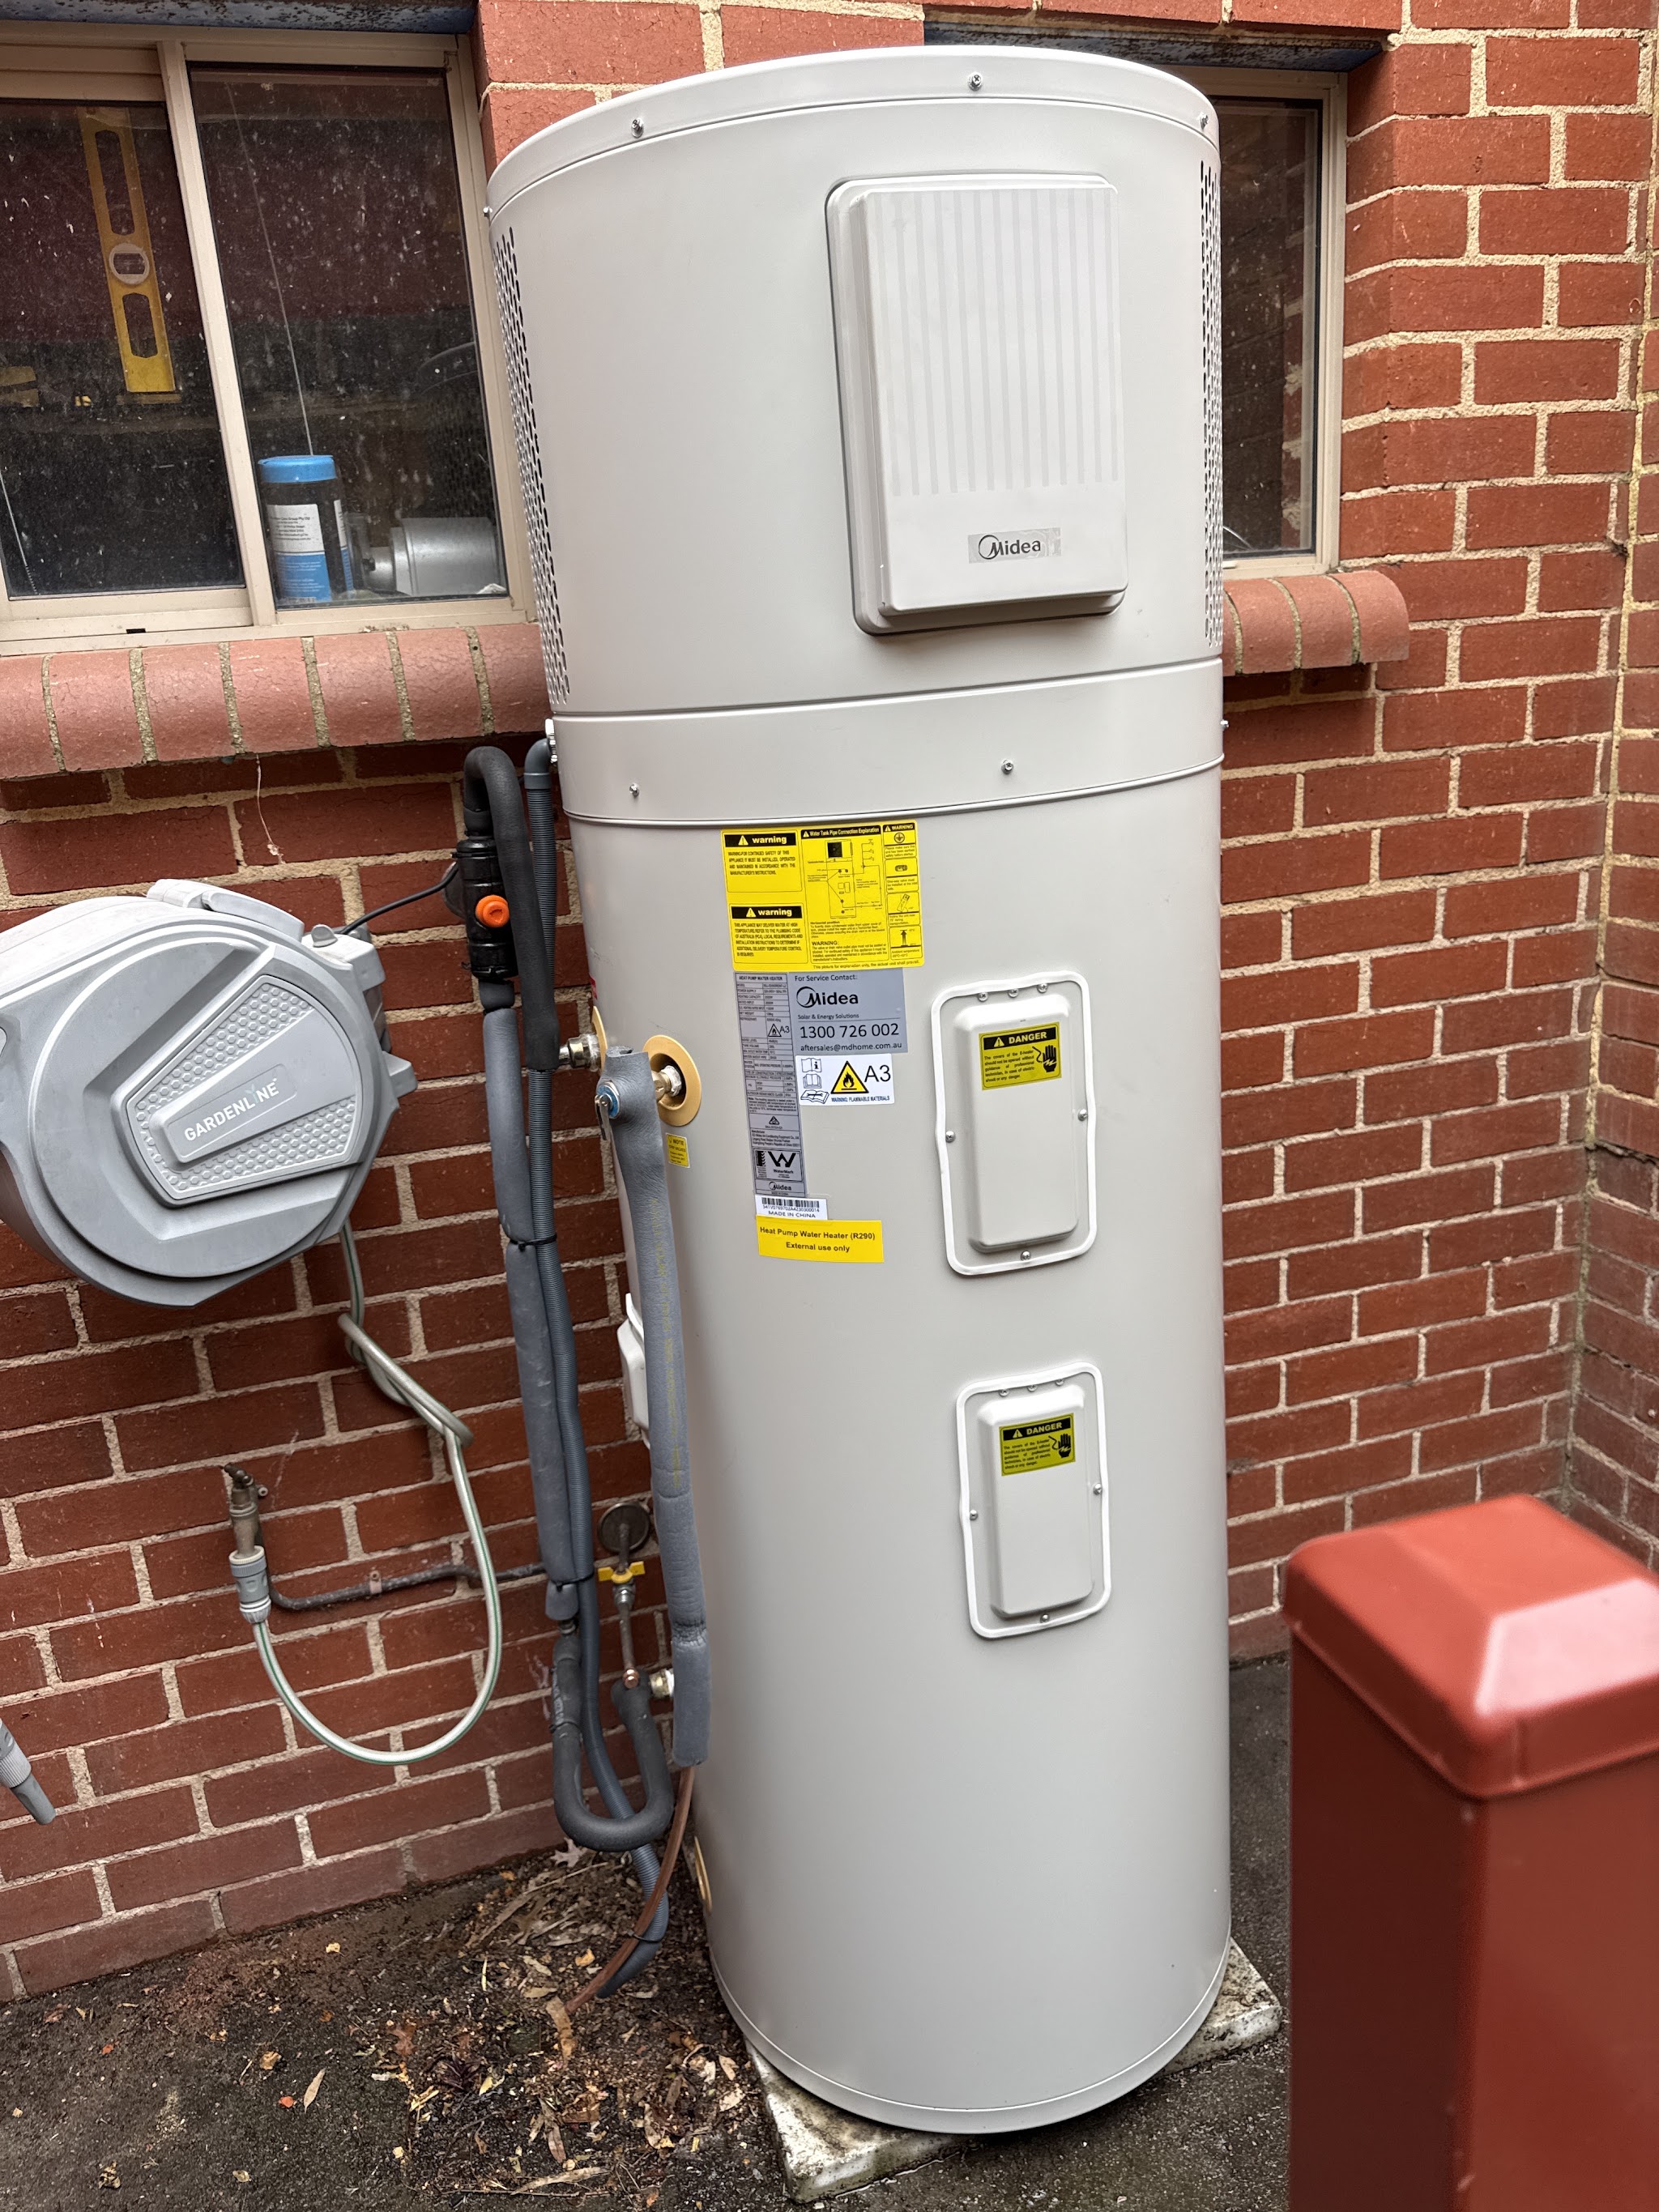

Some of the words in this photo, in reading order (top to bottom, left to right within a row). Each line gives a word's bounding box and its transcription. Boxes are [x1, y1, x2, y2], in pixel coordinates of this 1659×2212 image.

[979, 535, 1041, 560] Midea
[752, 836, 787, 844] warning
[758, 909, 792, 917] warning
[796, 987, 859, 1008] Midea
[800, 1025, 834, 1038] 1300
[839, 1025, 867, 1038] 726
[872, 1023, 899, 1036] 002
[1009, 1031, 1047, 1044] DANGER
[800, 1042, 902, 1051] aftersales@mdhome.com.au
[864, 1065, 891, 1082] A3
[769, 1182, 791, 1191] Midea
[778, 1229, 797, 1237] Pump
[851, 1232, 876, 1241] (R290)
[786, 1242, 815, 1250] External
[834, 1245, 850, 1253] only
[1026, 1422, 1062, 1435] DANGER
